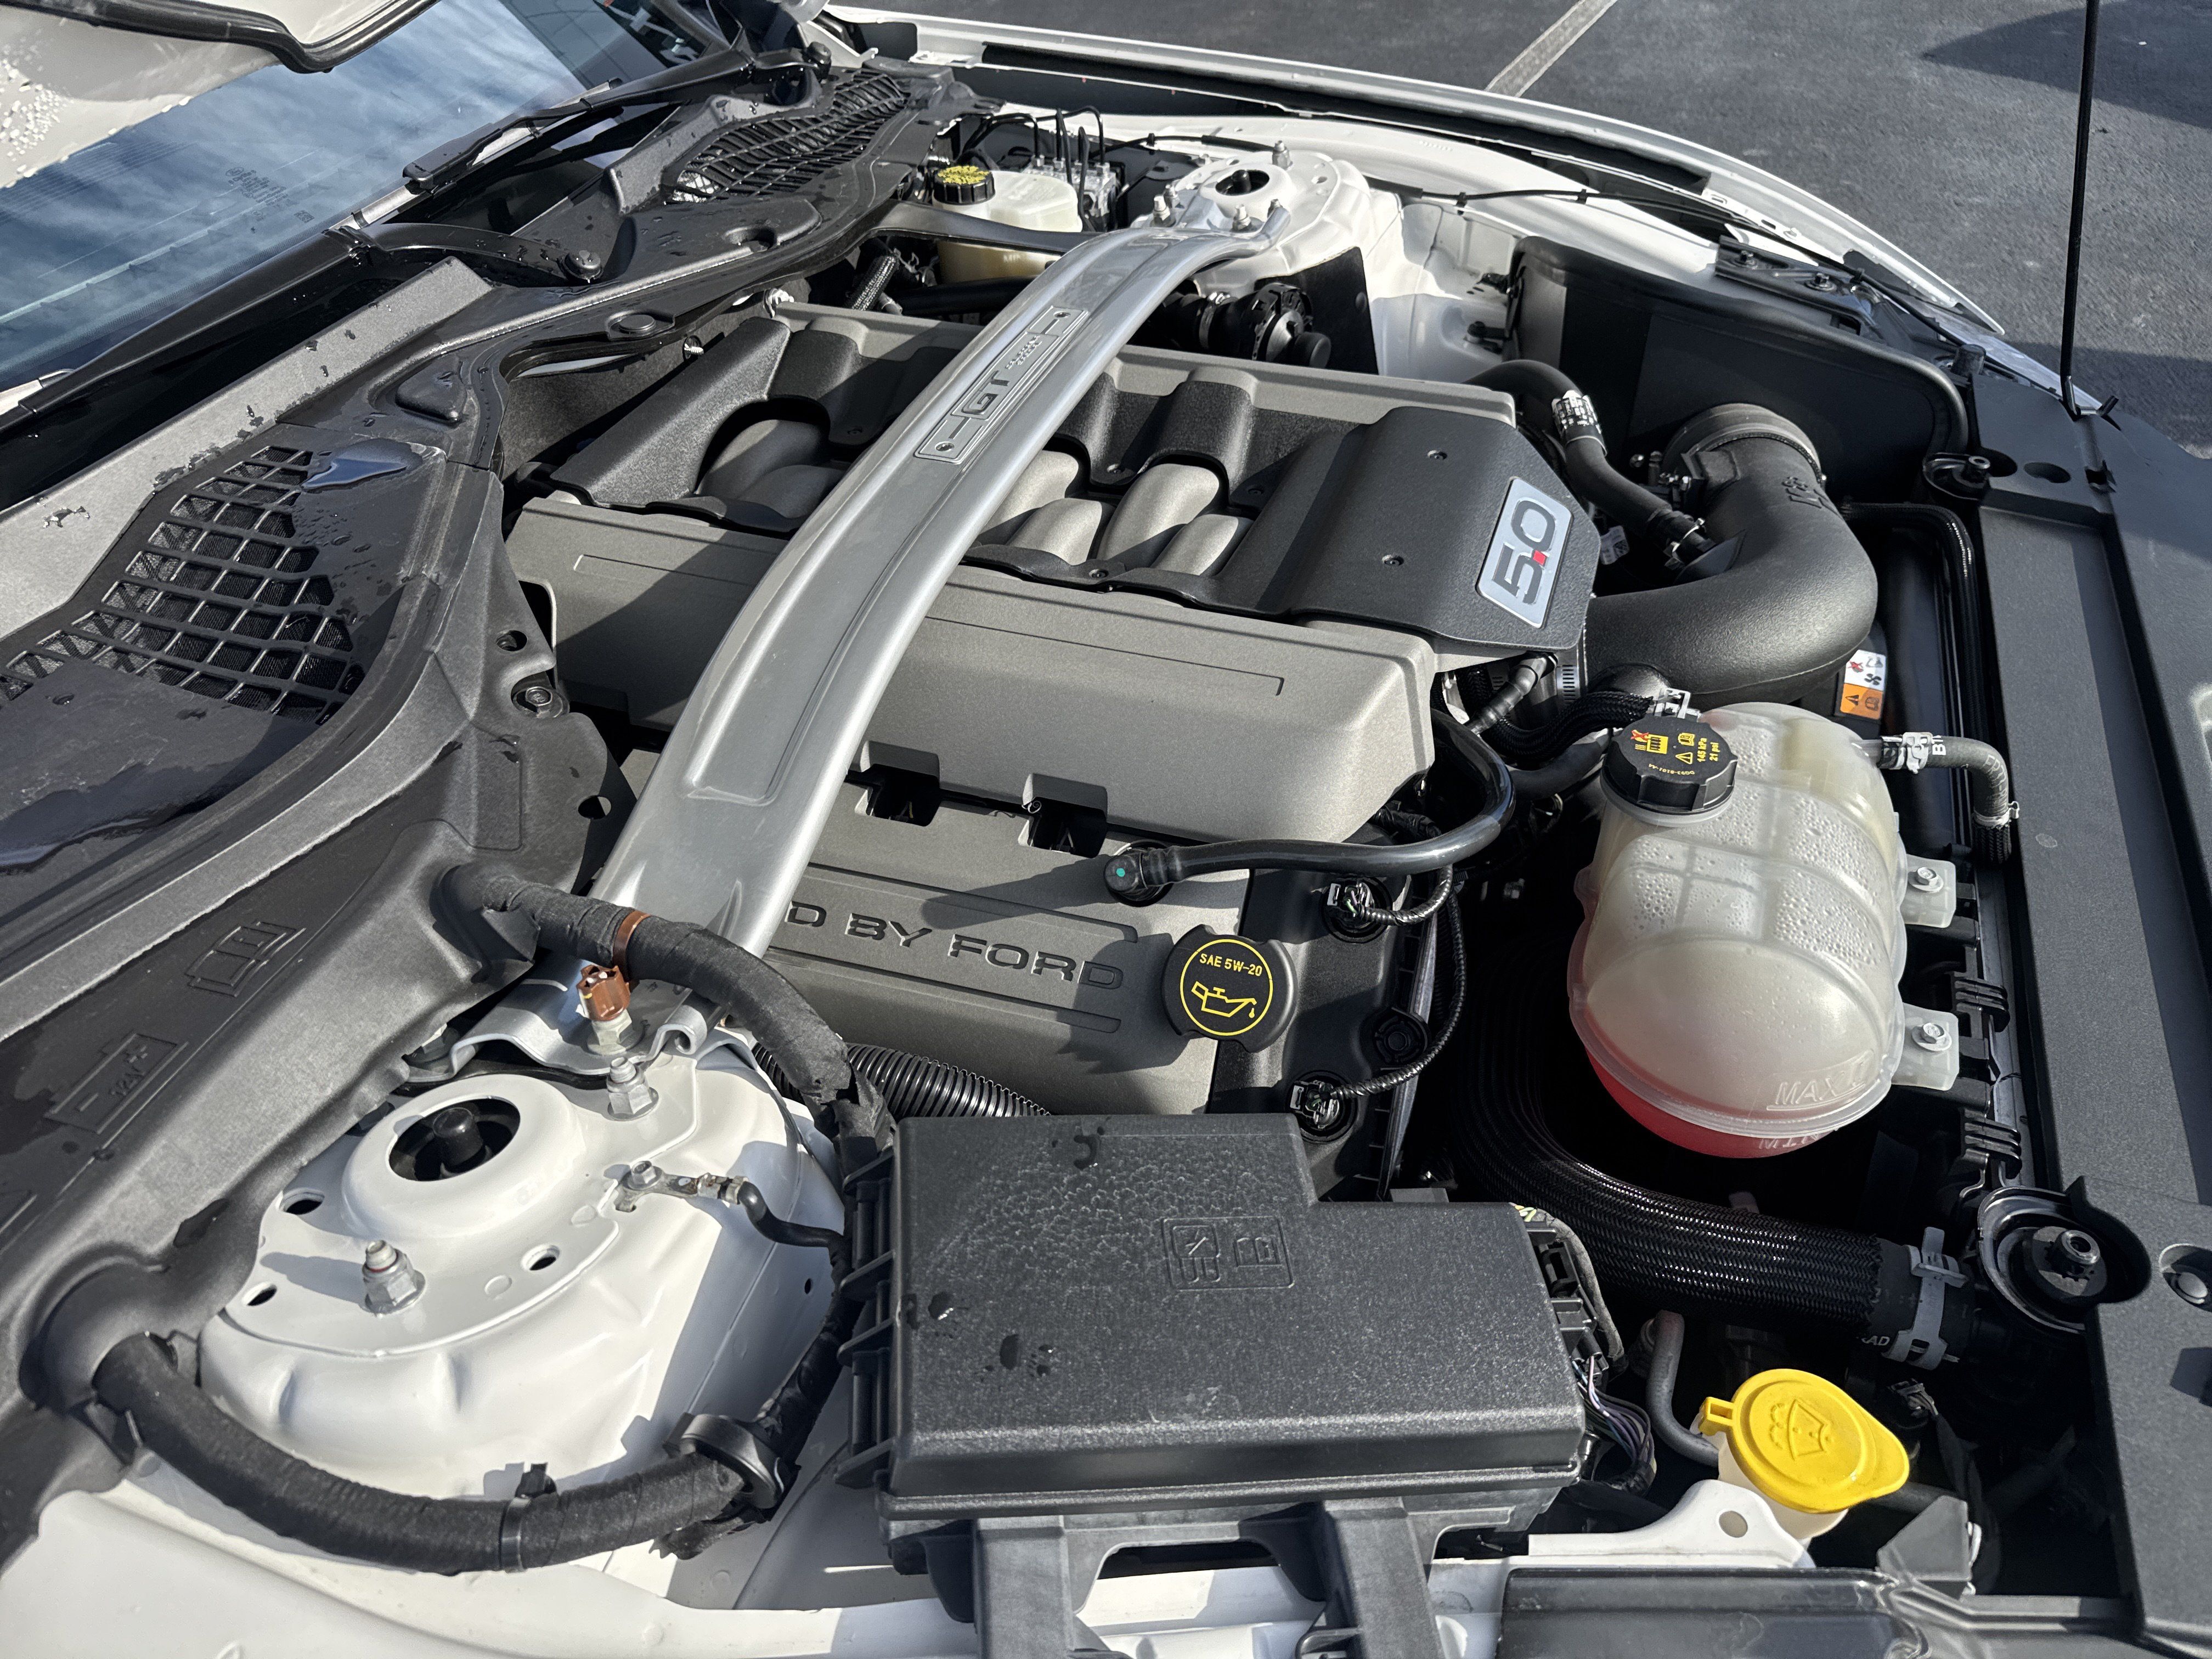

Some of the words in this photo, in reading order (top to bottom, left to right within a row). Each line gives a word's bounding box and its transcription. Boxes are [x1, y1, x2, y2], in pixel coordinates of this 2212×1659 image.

[961, 370, 1009, 415] GT
[1492, 498, 1556, 606] 5.0
[1697, 737, 1707, 750] kPa
[1697, 750, 1706, 763] 145
[1709, 753, 1718, 761] 21
[845, 913, 932, 947] BY
[947, 934, 1124, 990] FORD
[1199, 953, 1222, 968] SAE
[1224, 958, 1262, 977] 5W-20
[1775, 1077, 1839, 1105] MAX
